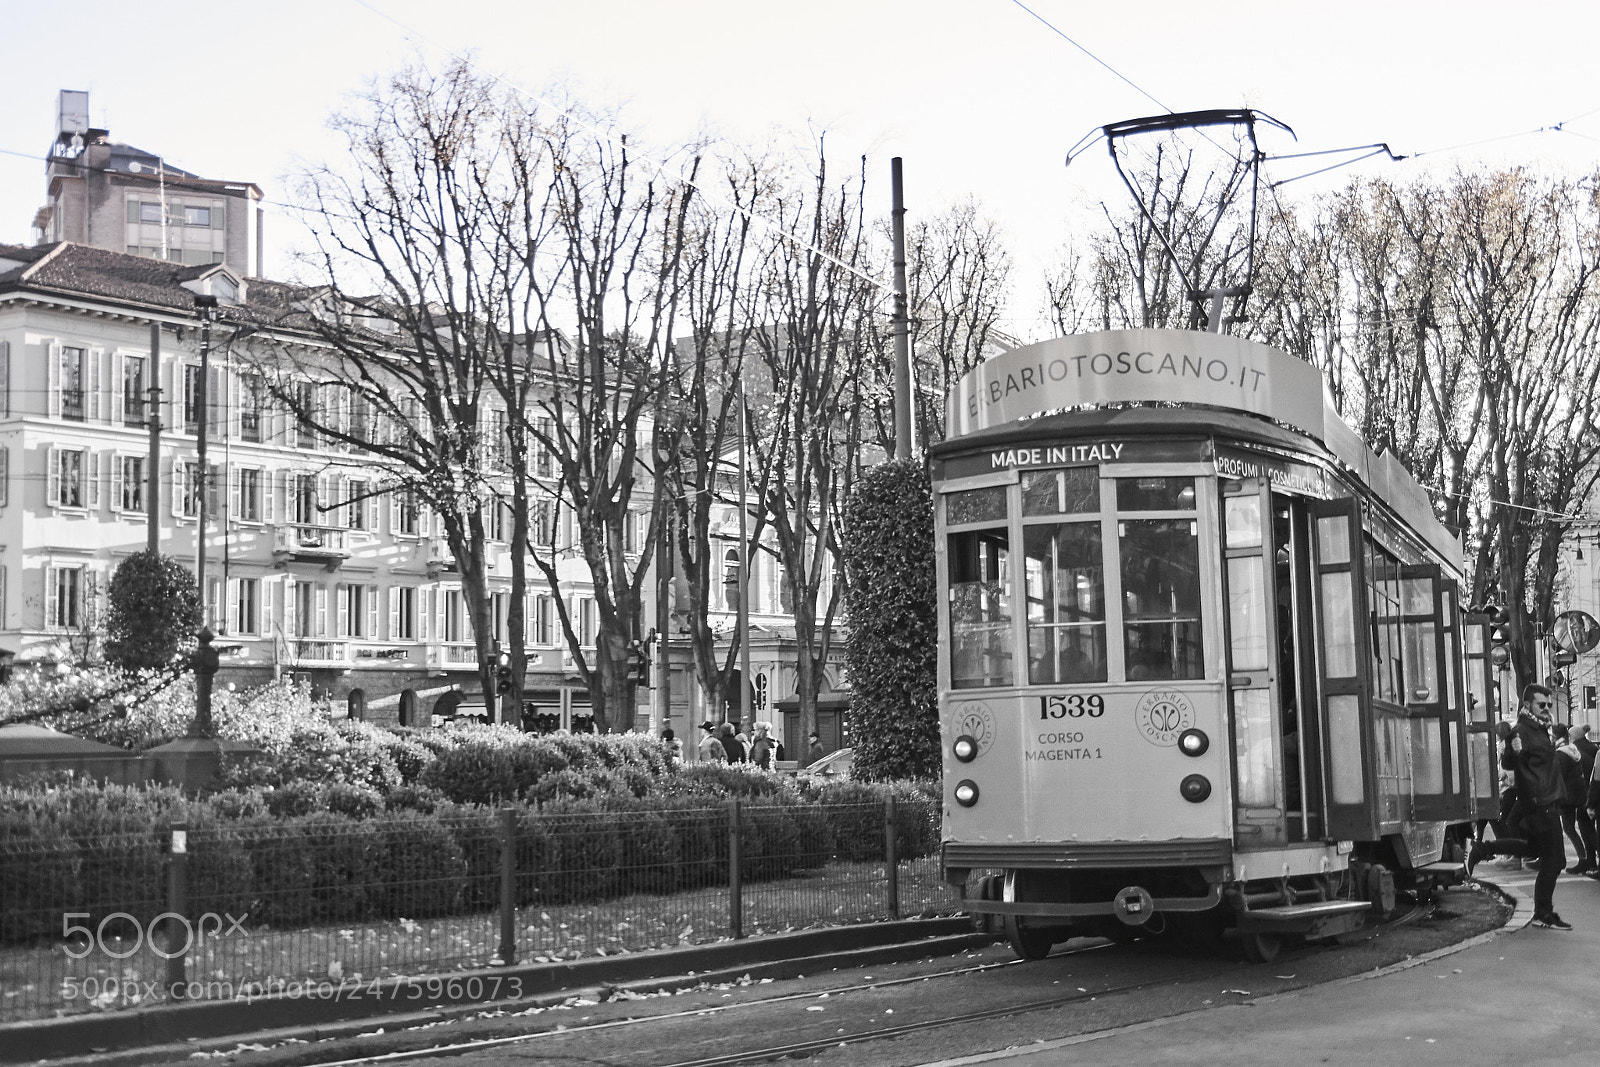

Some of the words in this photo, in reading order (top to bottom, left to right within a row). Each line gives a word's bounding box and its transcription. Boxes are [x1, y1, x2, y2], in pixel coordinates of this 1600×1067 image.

[991, 449, 1041, 468] MADE
[1046, 447, 1067, 464] IN
[1071, 443, 1123, 462] ITALY
[1218, 456, 1258, 478] PROFUMI
[1040, 693, 1105, 720] 1539
[1142, 692, 1188, 711] ERBARIO
[1038, 732, 1084, 745] CORSO
[1025, 748, 1092, 761] MAGENTA
[1095, 747, 1103, 759] 1
